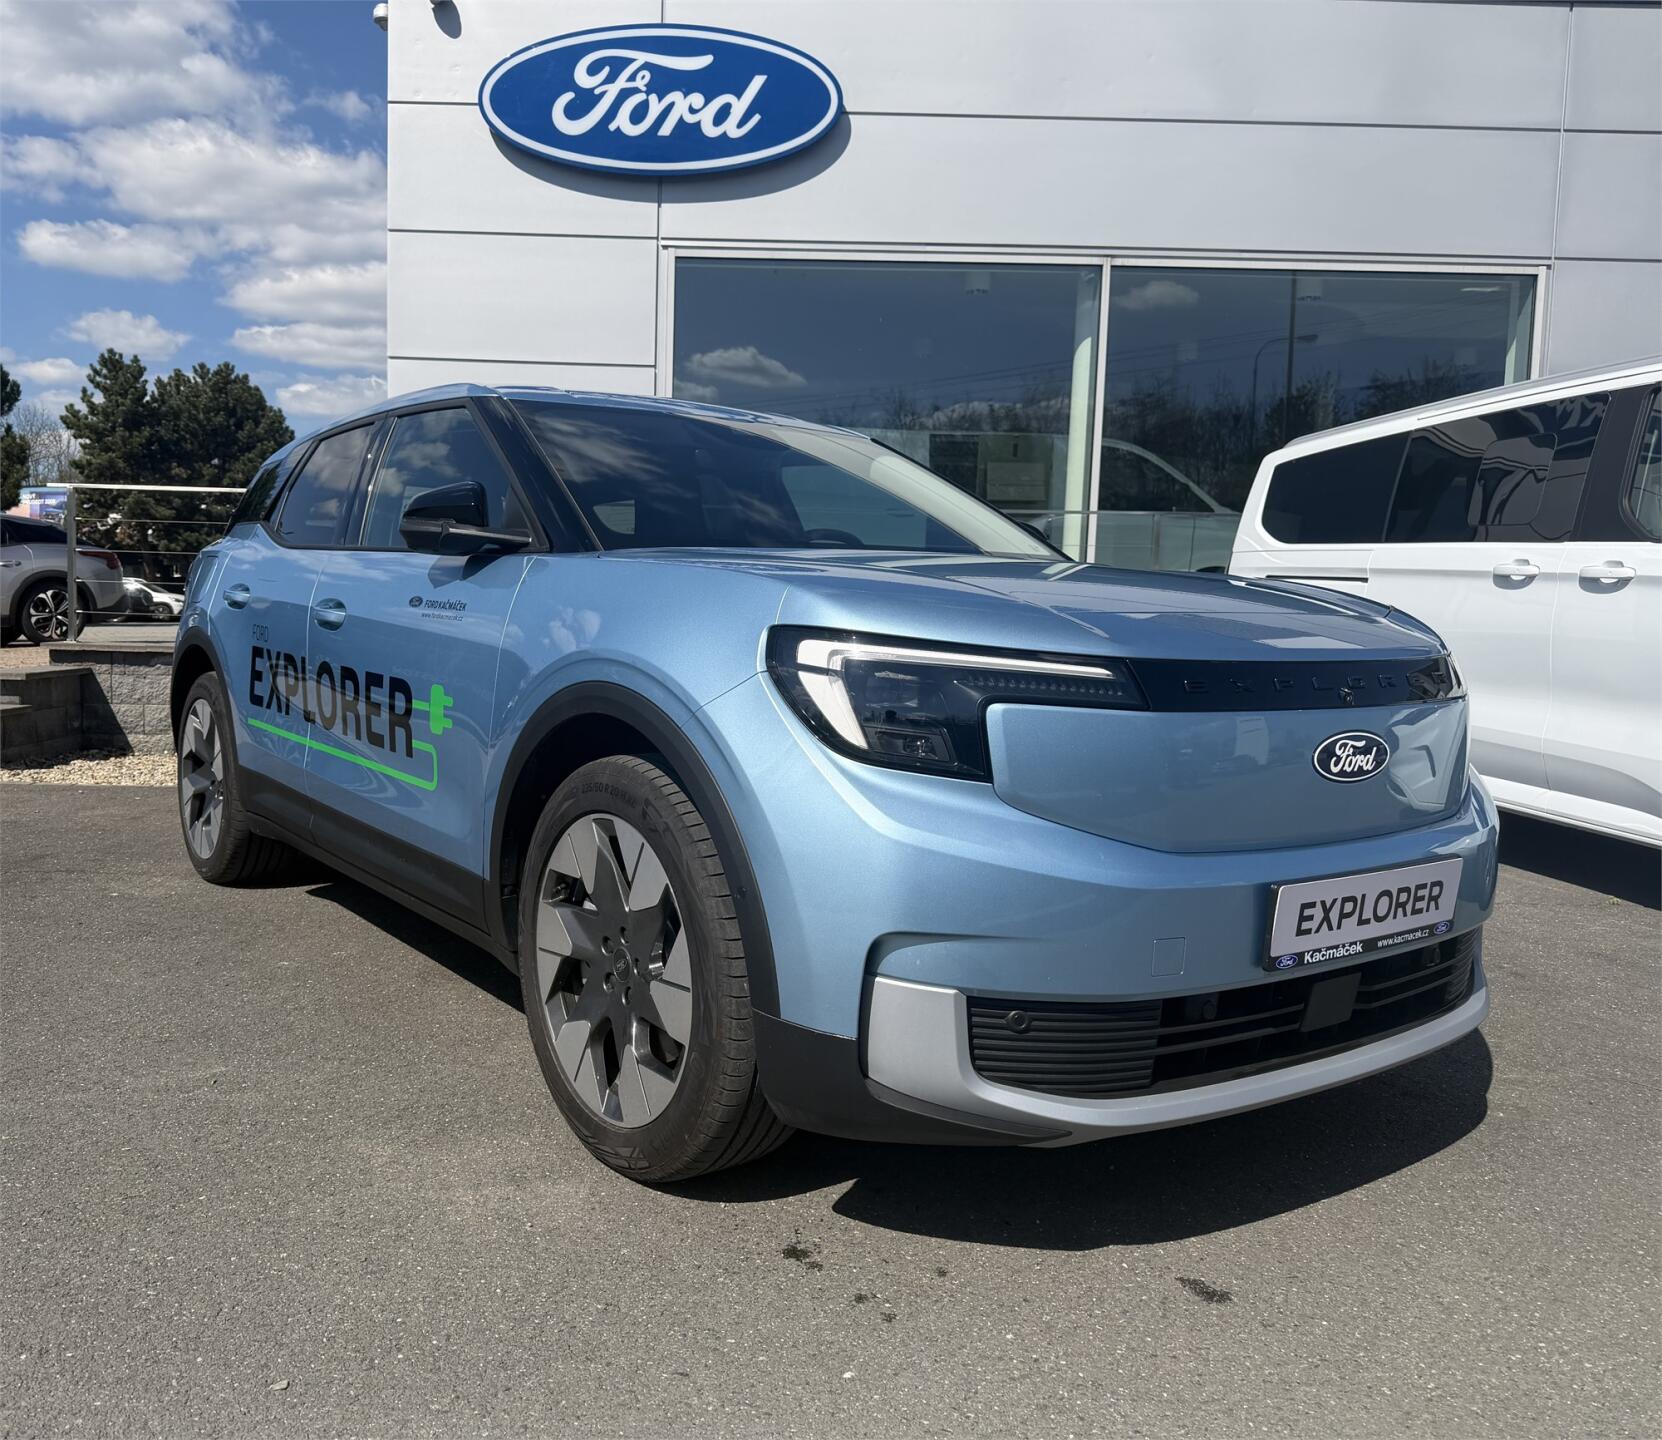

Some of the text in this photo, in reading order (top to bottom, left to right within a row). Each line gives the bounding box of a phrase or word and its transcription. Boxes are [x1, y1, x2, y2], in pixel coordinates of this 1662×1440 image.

[552, 48, 768, 138] Ford
[424, 599, 438, 609] FORD
[252, 624, 269, 642] FORD
[1183, 671, 1449, 694] EXPLORER
[250, 645, 414, 759] EXPLORER
[1330, 739, 1377, 774] Ford
[1295, 880, 1444, 937] EXPLORER
[1304, 941, 1363, 964] Kačmáček
[1377, 929, 1430, 948] www.kacmacek.cz
